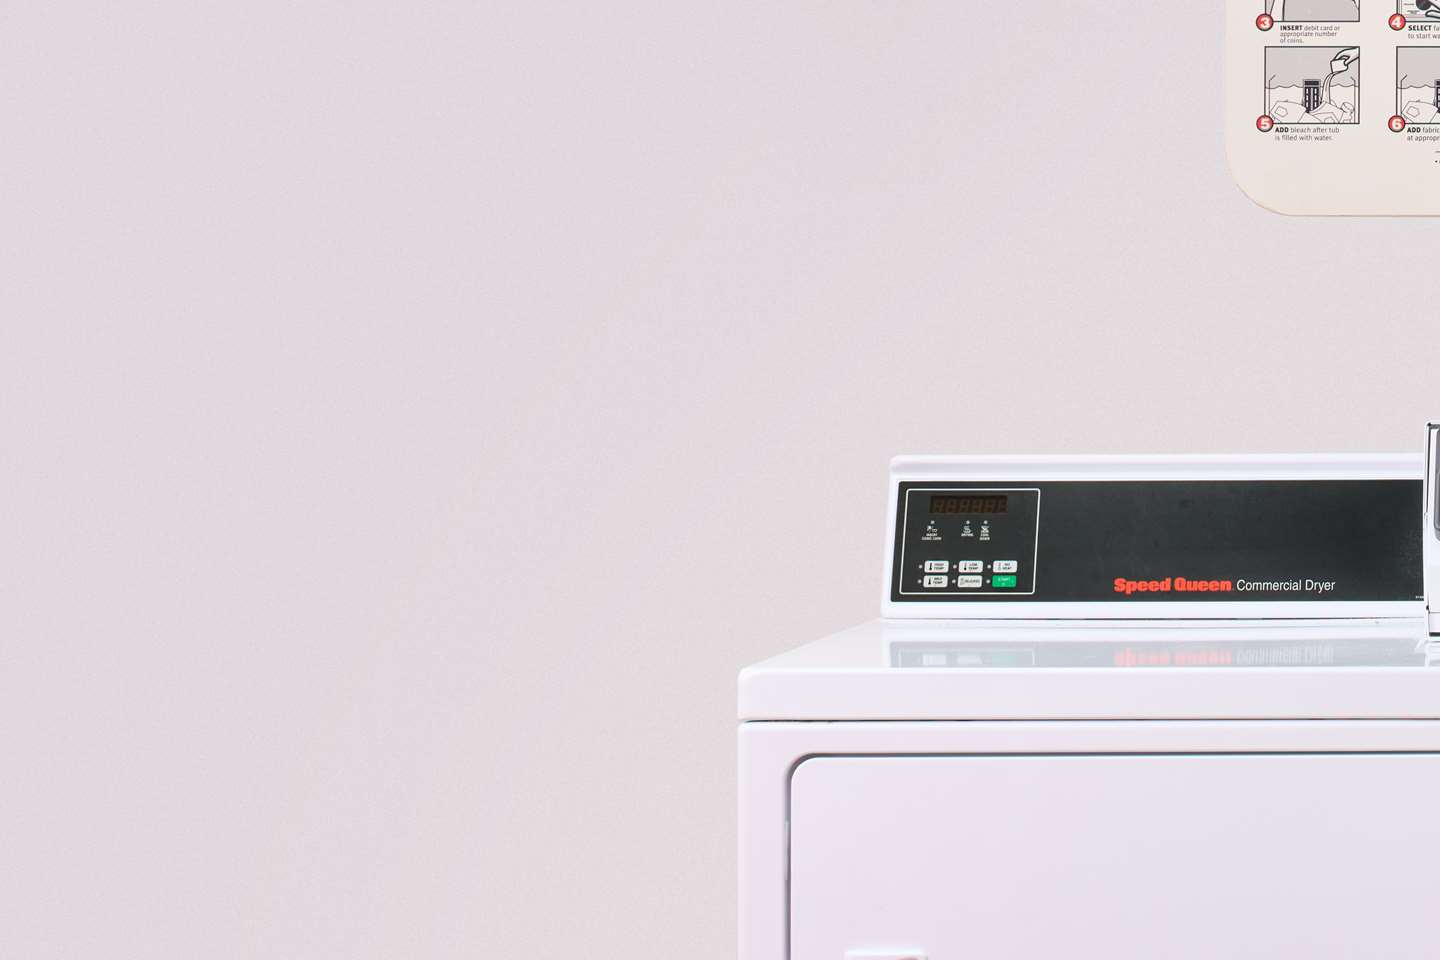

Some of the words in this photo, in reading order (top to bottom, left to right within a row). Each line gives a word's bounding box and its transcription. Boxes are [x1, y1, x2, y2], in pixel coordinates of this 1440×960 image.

[1114, 577, 1171, 594] Speed
[1174, 577, 1232, 592] Queen
[1237, 579, 1302, 591] Commercial
[1305, 579, 1336, 594] Dryer
